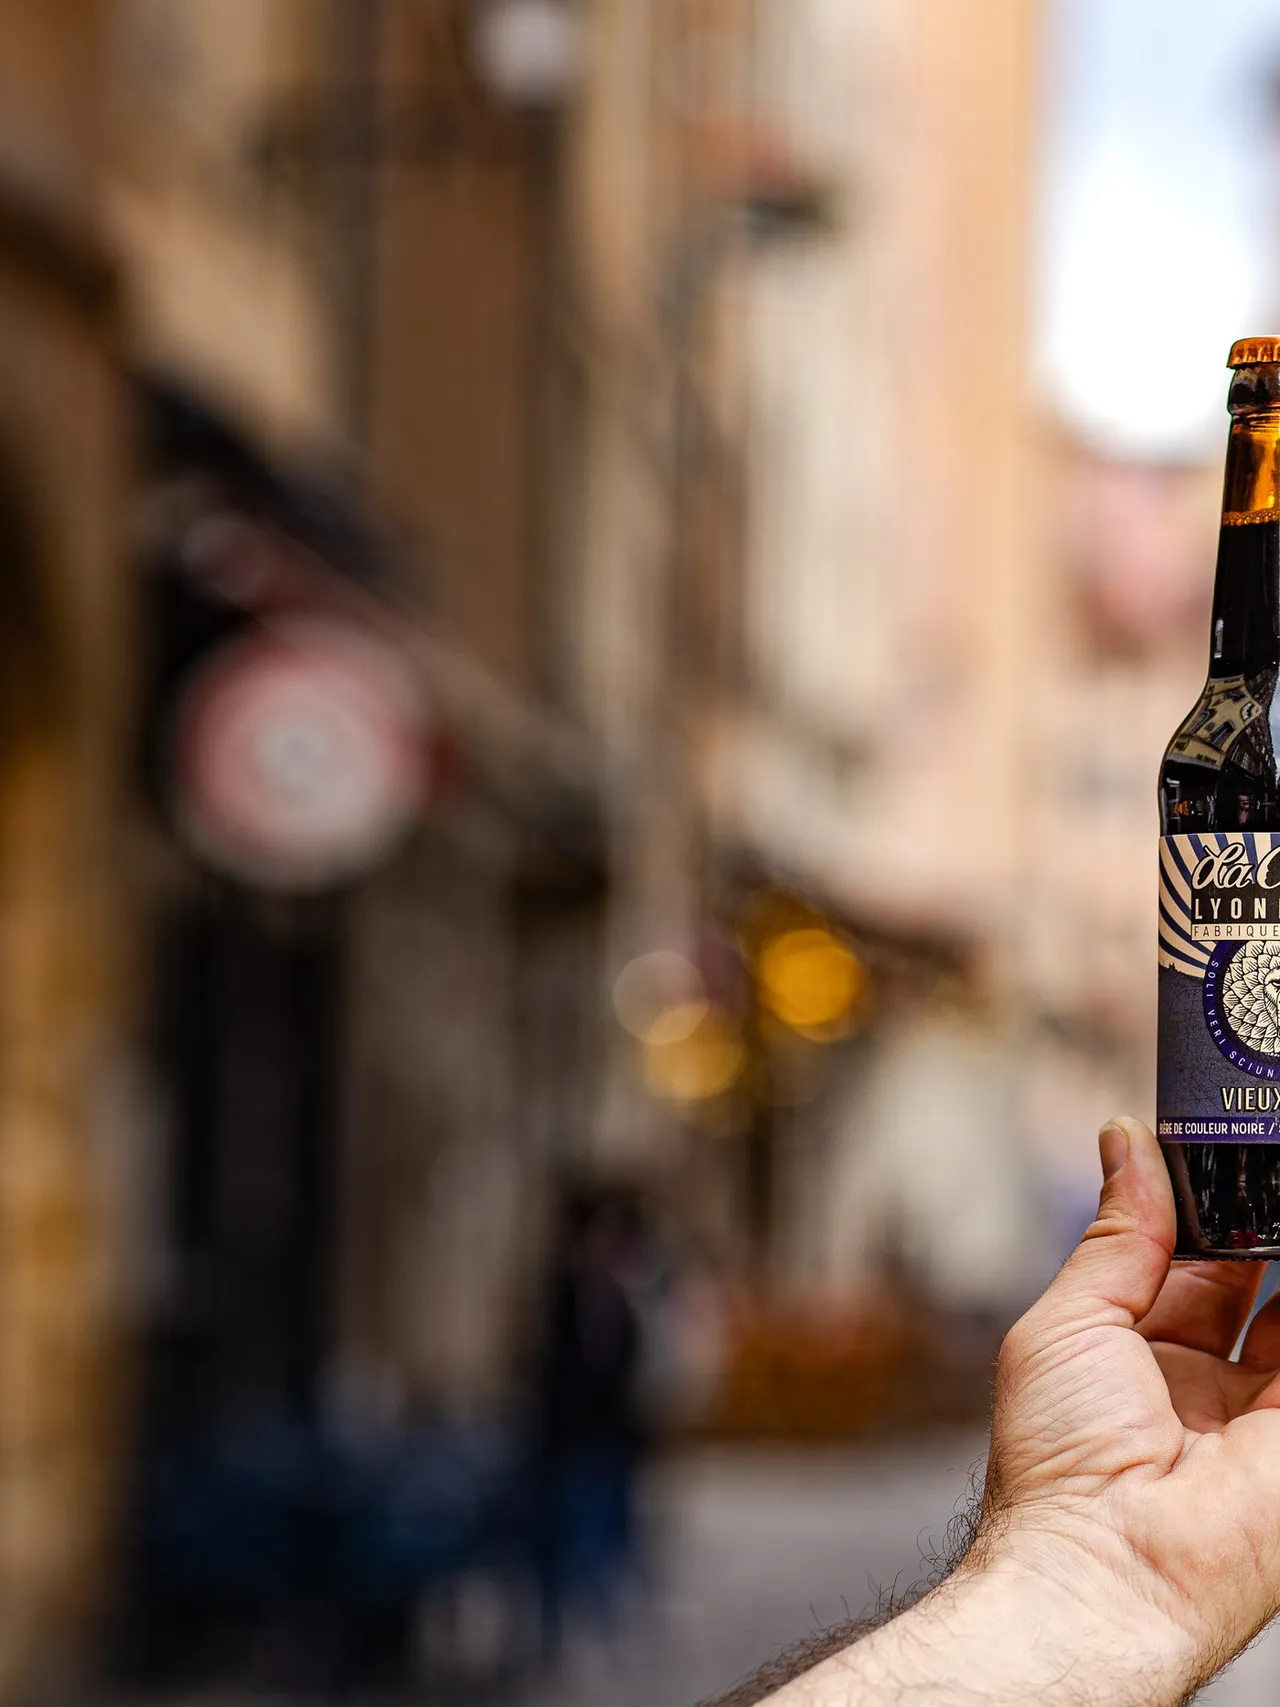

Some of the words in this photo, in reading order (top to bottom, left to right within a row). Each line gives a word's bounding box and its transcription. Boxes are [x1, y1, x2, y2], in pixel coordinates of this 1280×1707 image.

[1192, 842, 1255, 890] La
[1194, 925, 1280, 938] FABRIQUE
[1206, 960, 1219, 997] SOLI
[1207, 1009, 1226, 1045] VERI
[1174, 1122, 1184, 1135] DE
[1185, 1122, 1228, 1135] COULEUR
[1231, 1122, 1265, 1135] NOIRE
